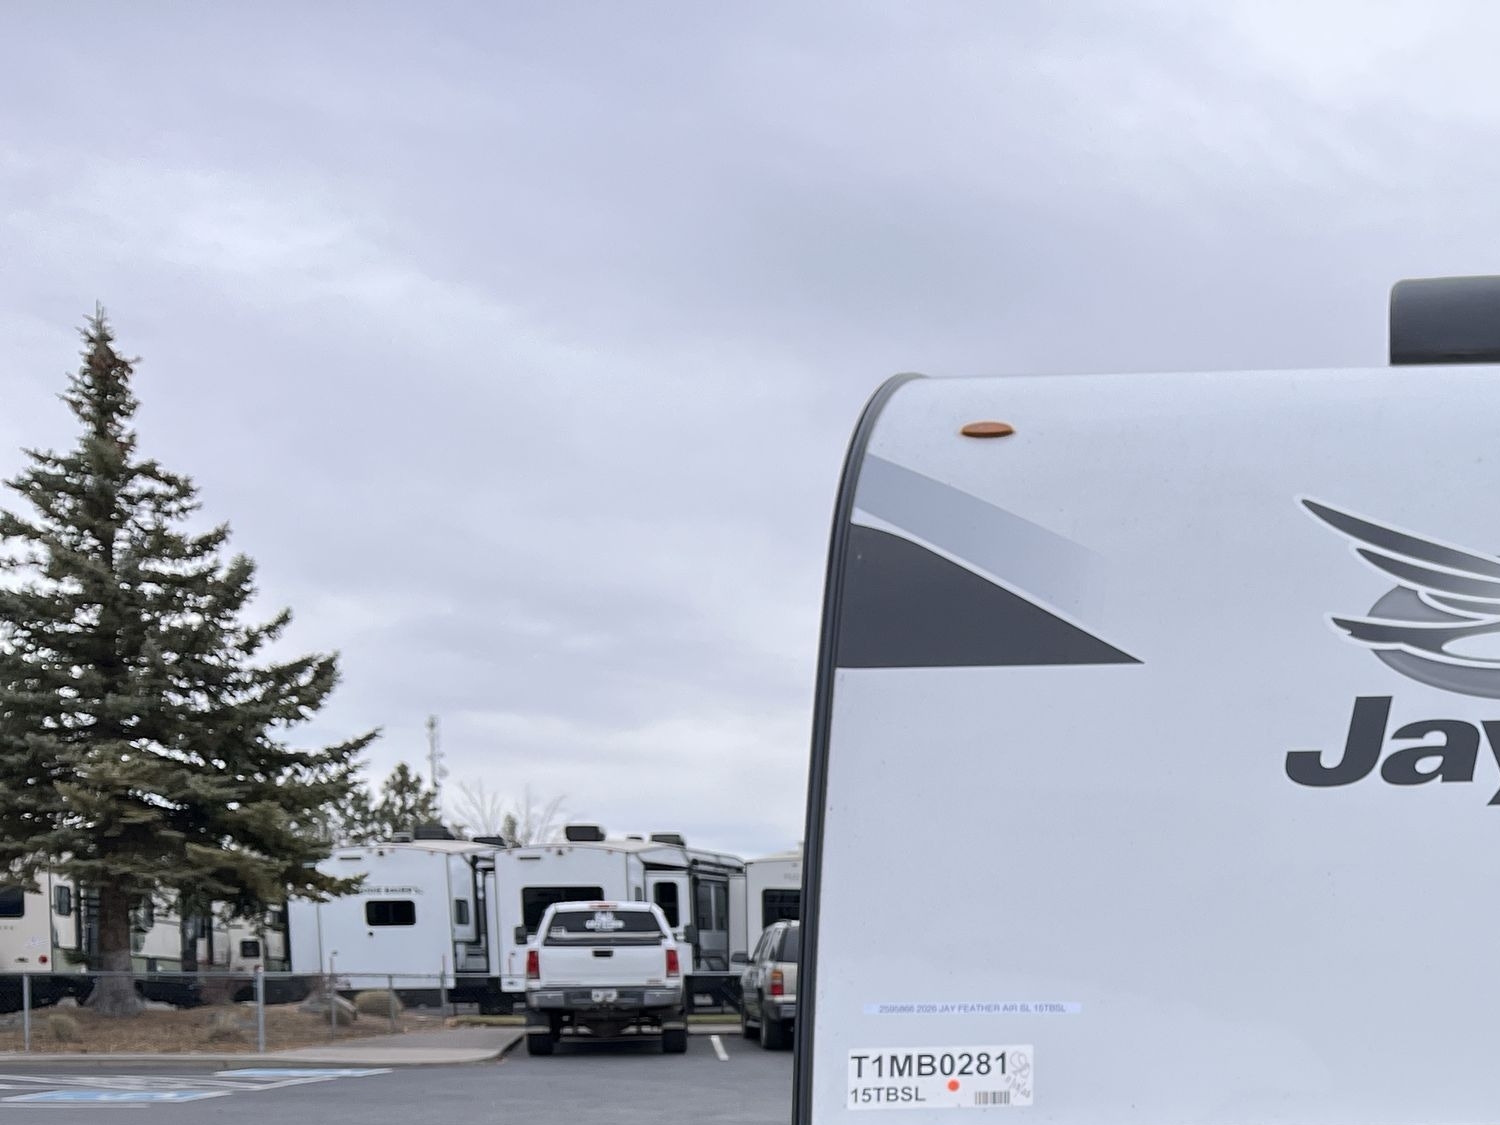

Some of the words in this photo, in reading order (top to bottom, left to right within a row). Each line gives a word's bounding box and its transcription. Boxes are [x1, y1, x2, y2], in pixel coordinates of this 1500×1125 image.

[939, 1003, 956, 1013] JAY
[958, 1002, 1000, 1013] FEATHER
[850, 1051, 1006, 1078] T1MB0281
[850, 1087, 926, 1103] 15TBSL
